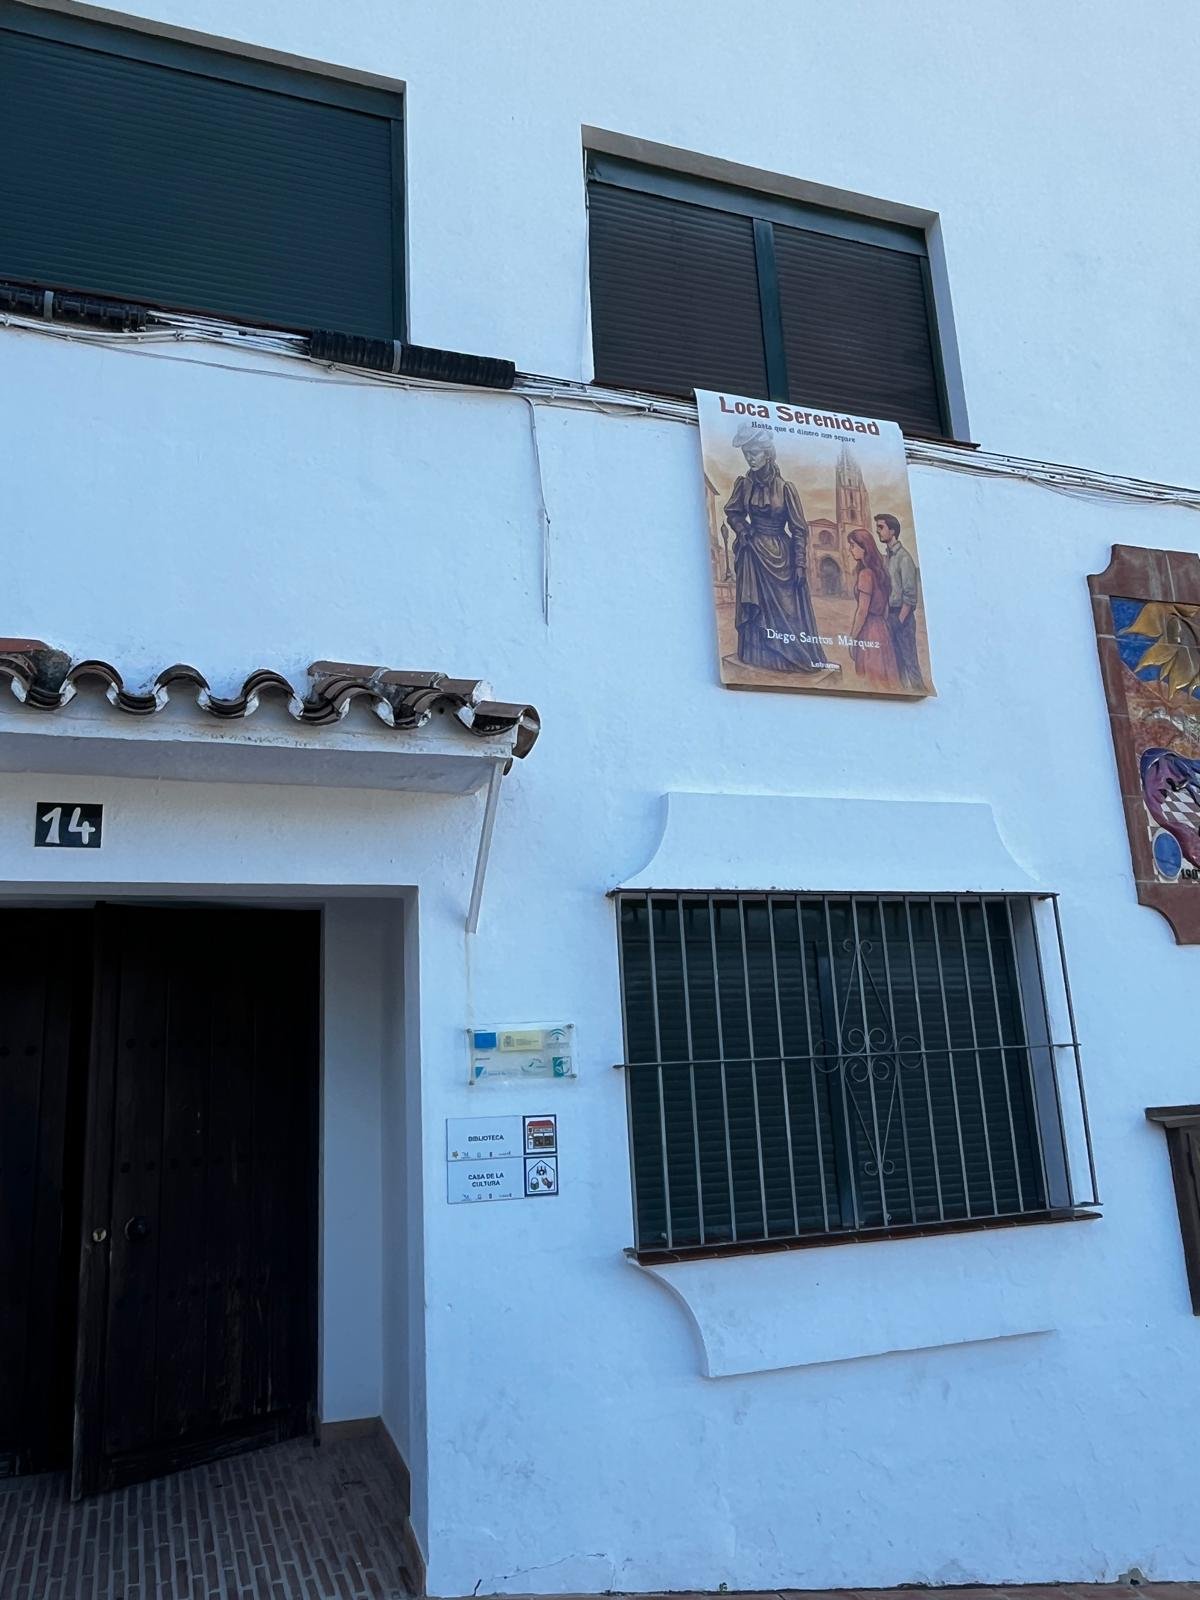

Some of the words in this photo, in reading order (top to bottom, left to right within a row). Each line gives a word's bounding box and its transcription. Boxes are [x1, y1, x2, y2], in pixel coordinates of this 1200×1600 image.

[718, 396, 770, 419] Loca
[775, 405, 881, 436] Serenidad
[751, 421, 773, 431] Hasta
[767, 628, 796, 643] Diego
[800, 632, 834, 645] Santos
[41, 807, 96, 845] 14
[467, 1134, 505, 1142] BIBLIOTECA
[471, 1180, 501, 1188] CULTURA
